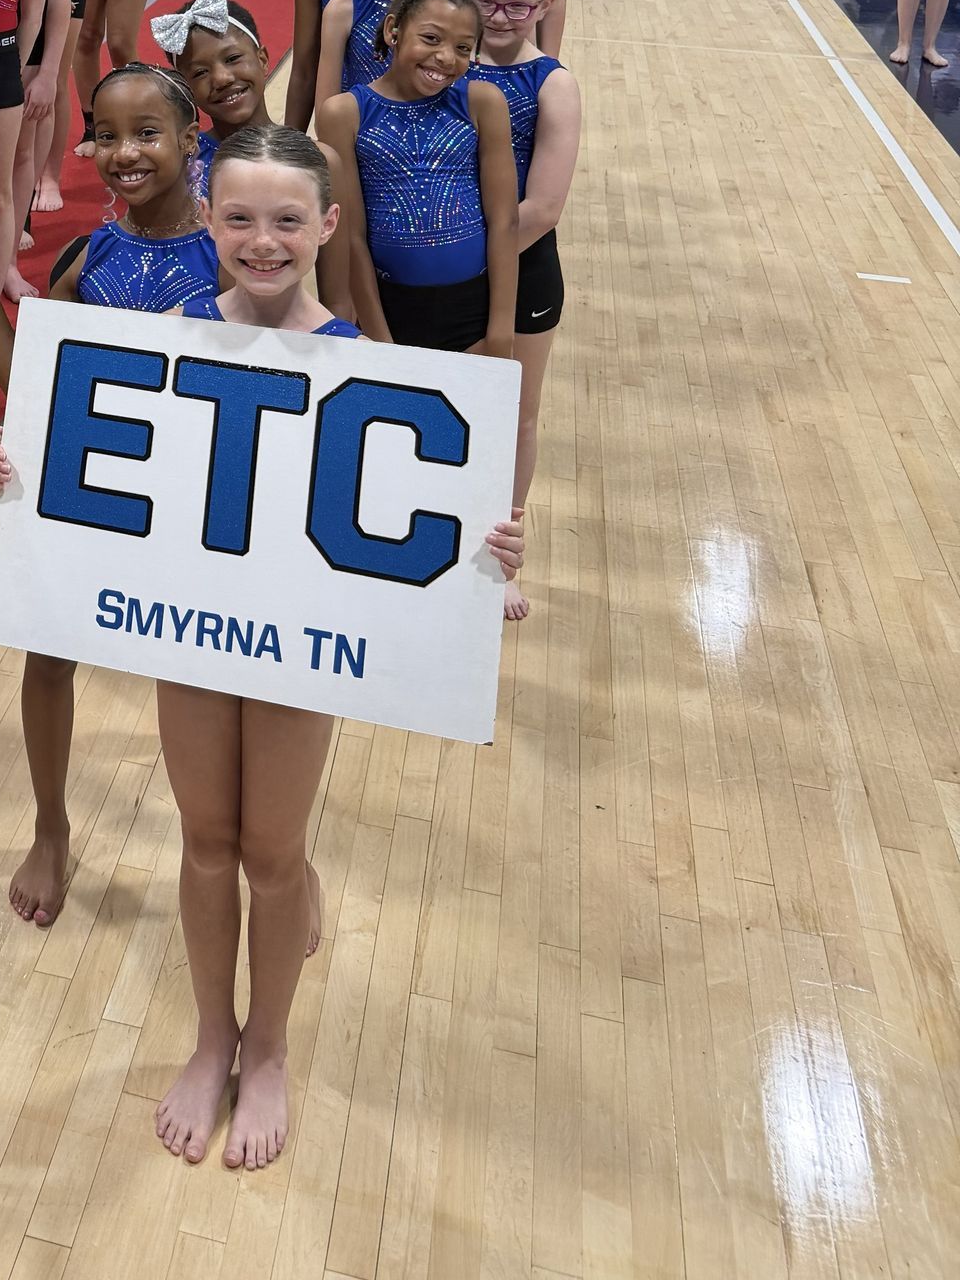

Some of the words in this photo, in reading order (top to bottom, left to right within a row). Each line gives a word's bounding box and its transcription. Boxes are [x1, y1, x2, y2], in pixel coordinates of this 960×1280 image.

[37, 338, 470, 587] ETC
[95, 588, 283, 663] SMYRNA
[303, 627, 367, 679] TN
